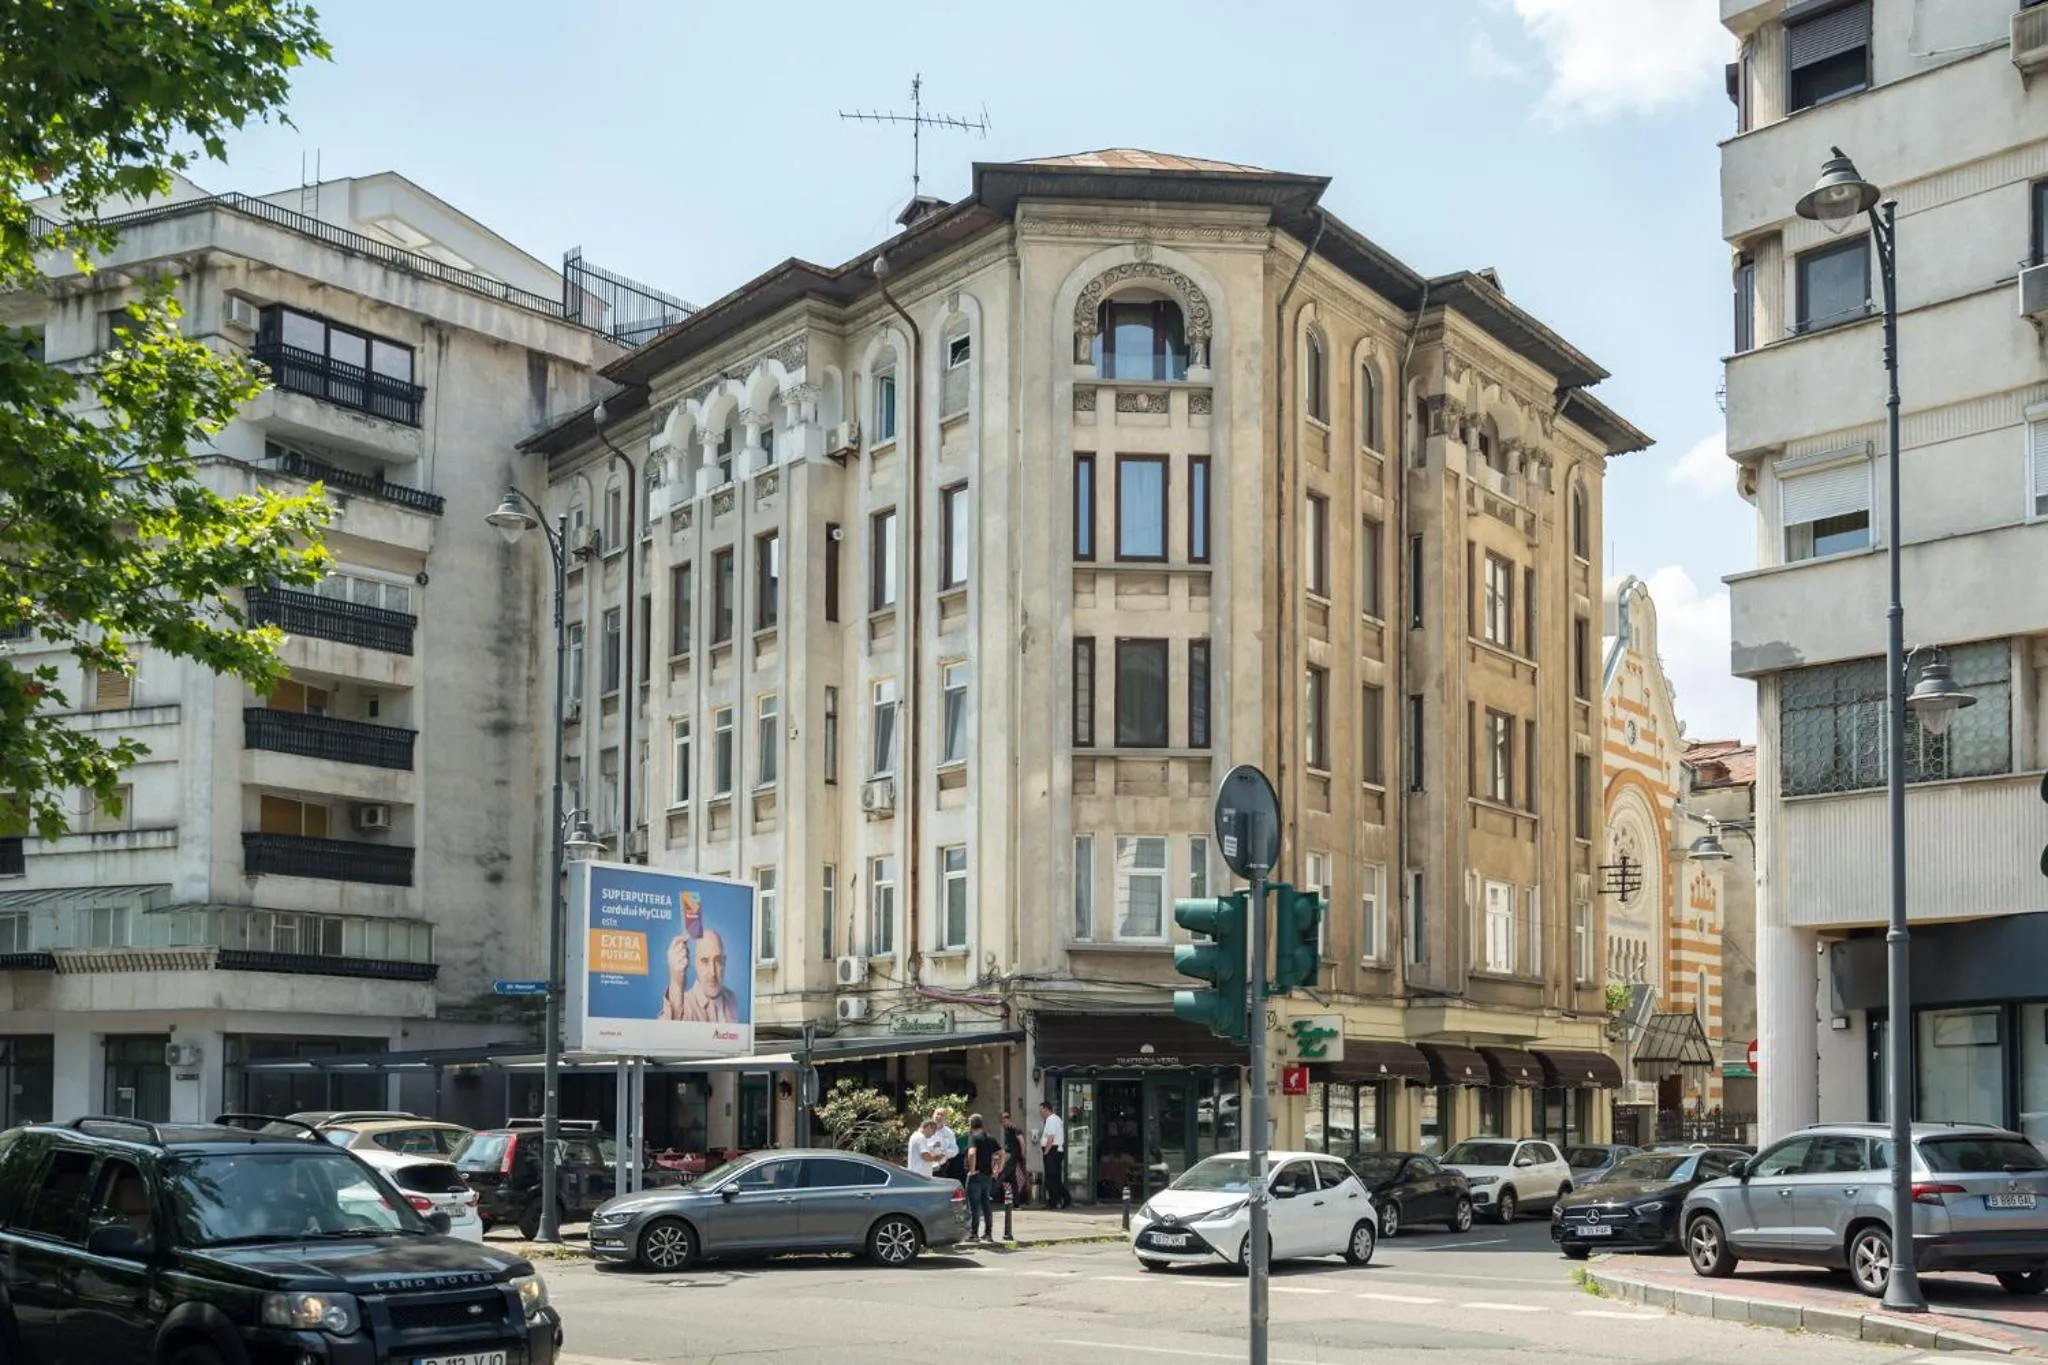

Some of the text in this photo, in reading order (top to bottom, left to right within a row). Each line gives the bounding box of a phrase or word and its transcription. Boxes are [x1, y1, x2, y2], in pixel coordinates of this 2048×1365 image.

[601, 888, 672, 906] SUPERPUTEREA
[638, 907, 672, 920] MyCLUB
[601, 934, 640, 949] EXTRA
[373, 1273, 493, 1290] LAND ROVER
